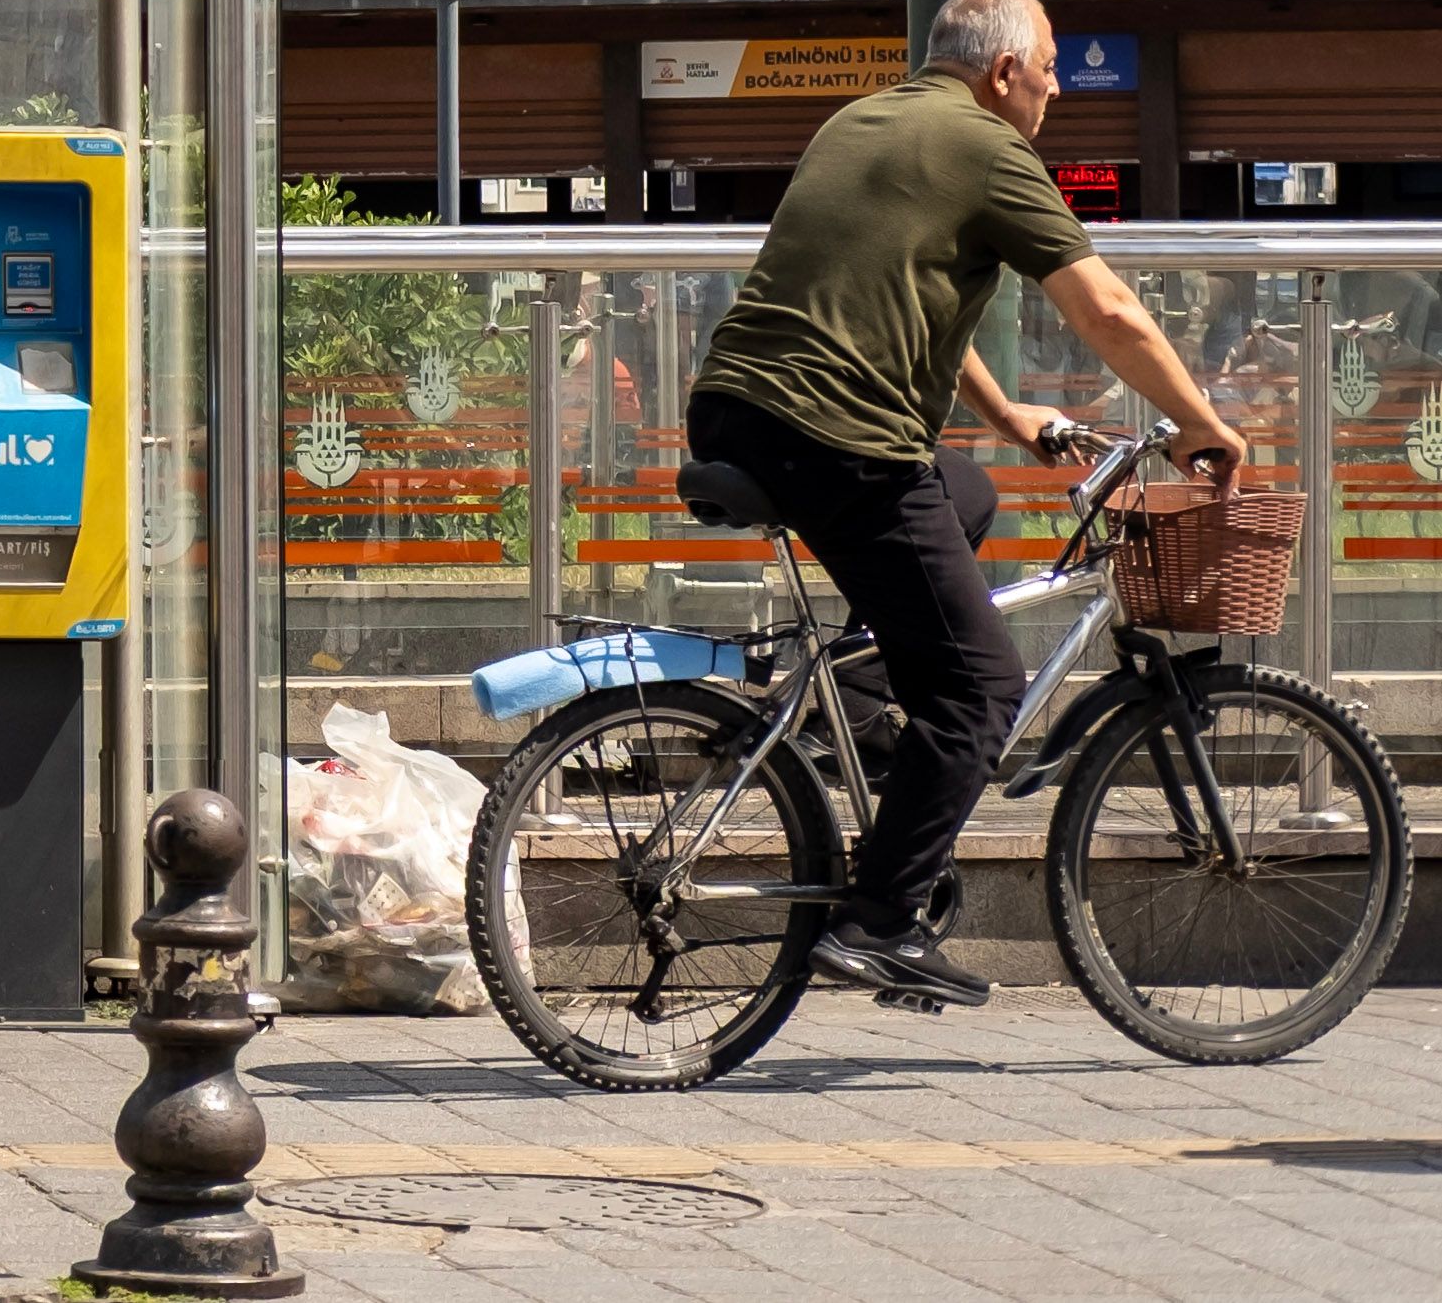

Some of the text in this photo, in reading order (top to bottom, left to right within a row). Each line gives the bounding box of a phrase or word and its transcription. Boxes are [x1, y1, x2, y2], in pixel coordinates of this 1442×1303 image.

[765, 46, 852, 65] EMİNÖNÜ
[857, 50, 866, 63] 3
[745, 71, 805, 89] BOĞAZ
[809, 73, 859, 87] HATTI
